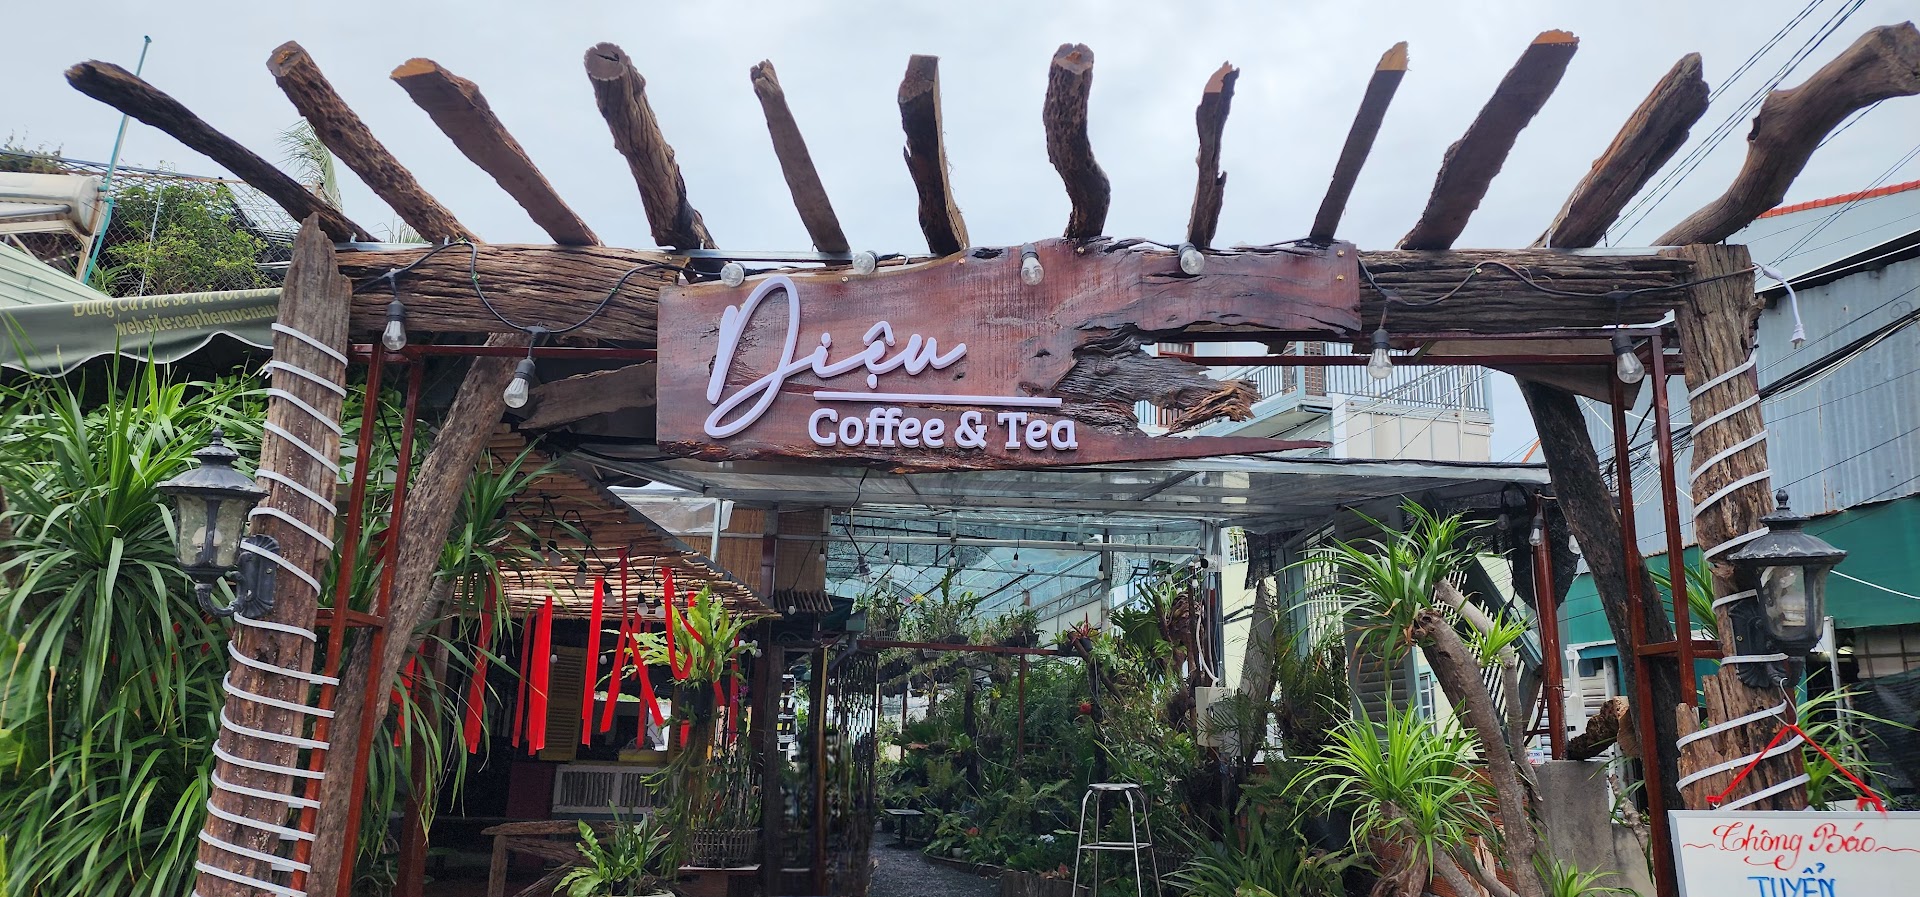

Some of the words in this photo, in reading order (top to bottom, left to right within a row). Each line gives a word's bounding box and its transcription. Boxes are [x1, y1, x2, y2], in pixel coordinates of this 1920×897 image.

[703, 275, 967, 439] Diệu
[808, 407, 945, 449] Coffee
[954, 410, 988, 450] &
[997, 411, 1079, 451] Tea
[1808, 822, 1876, 854] Báo
